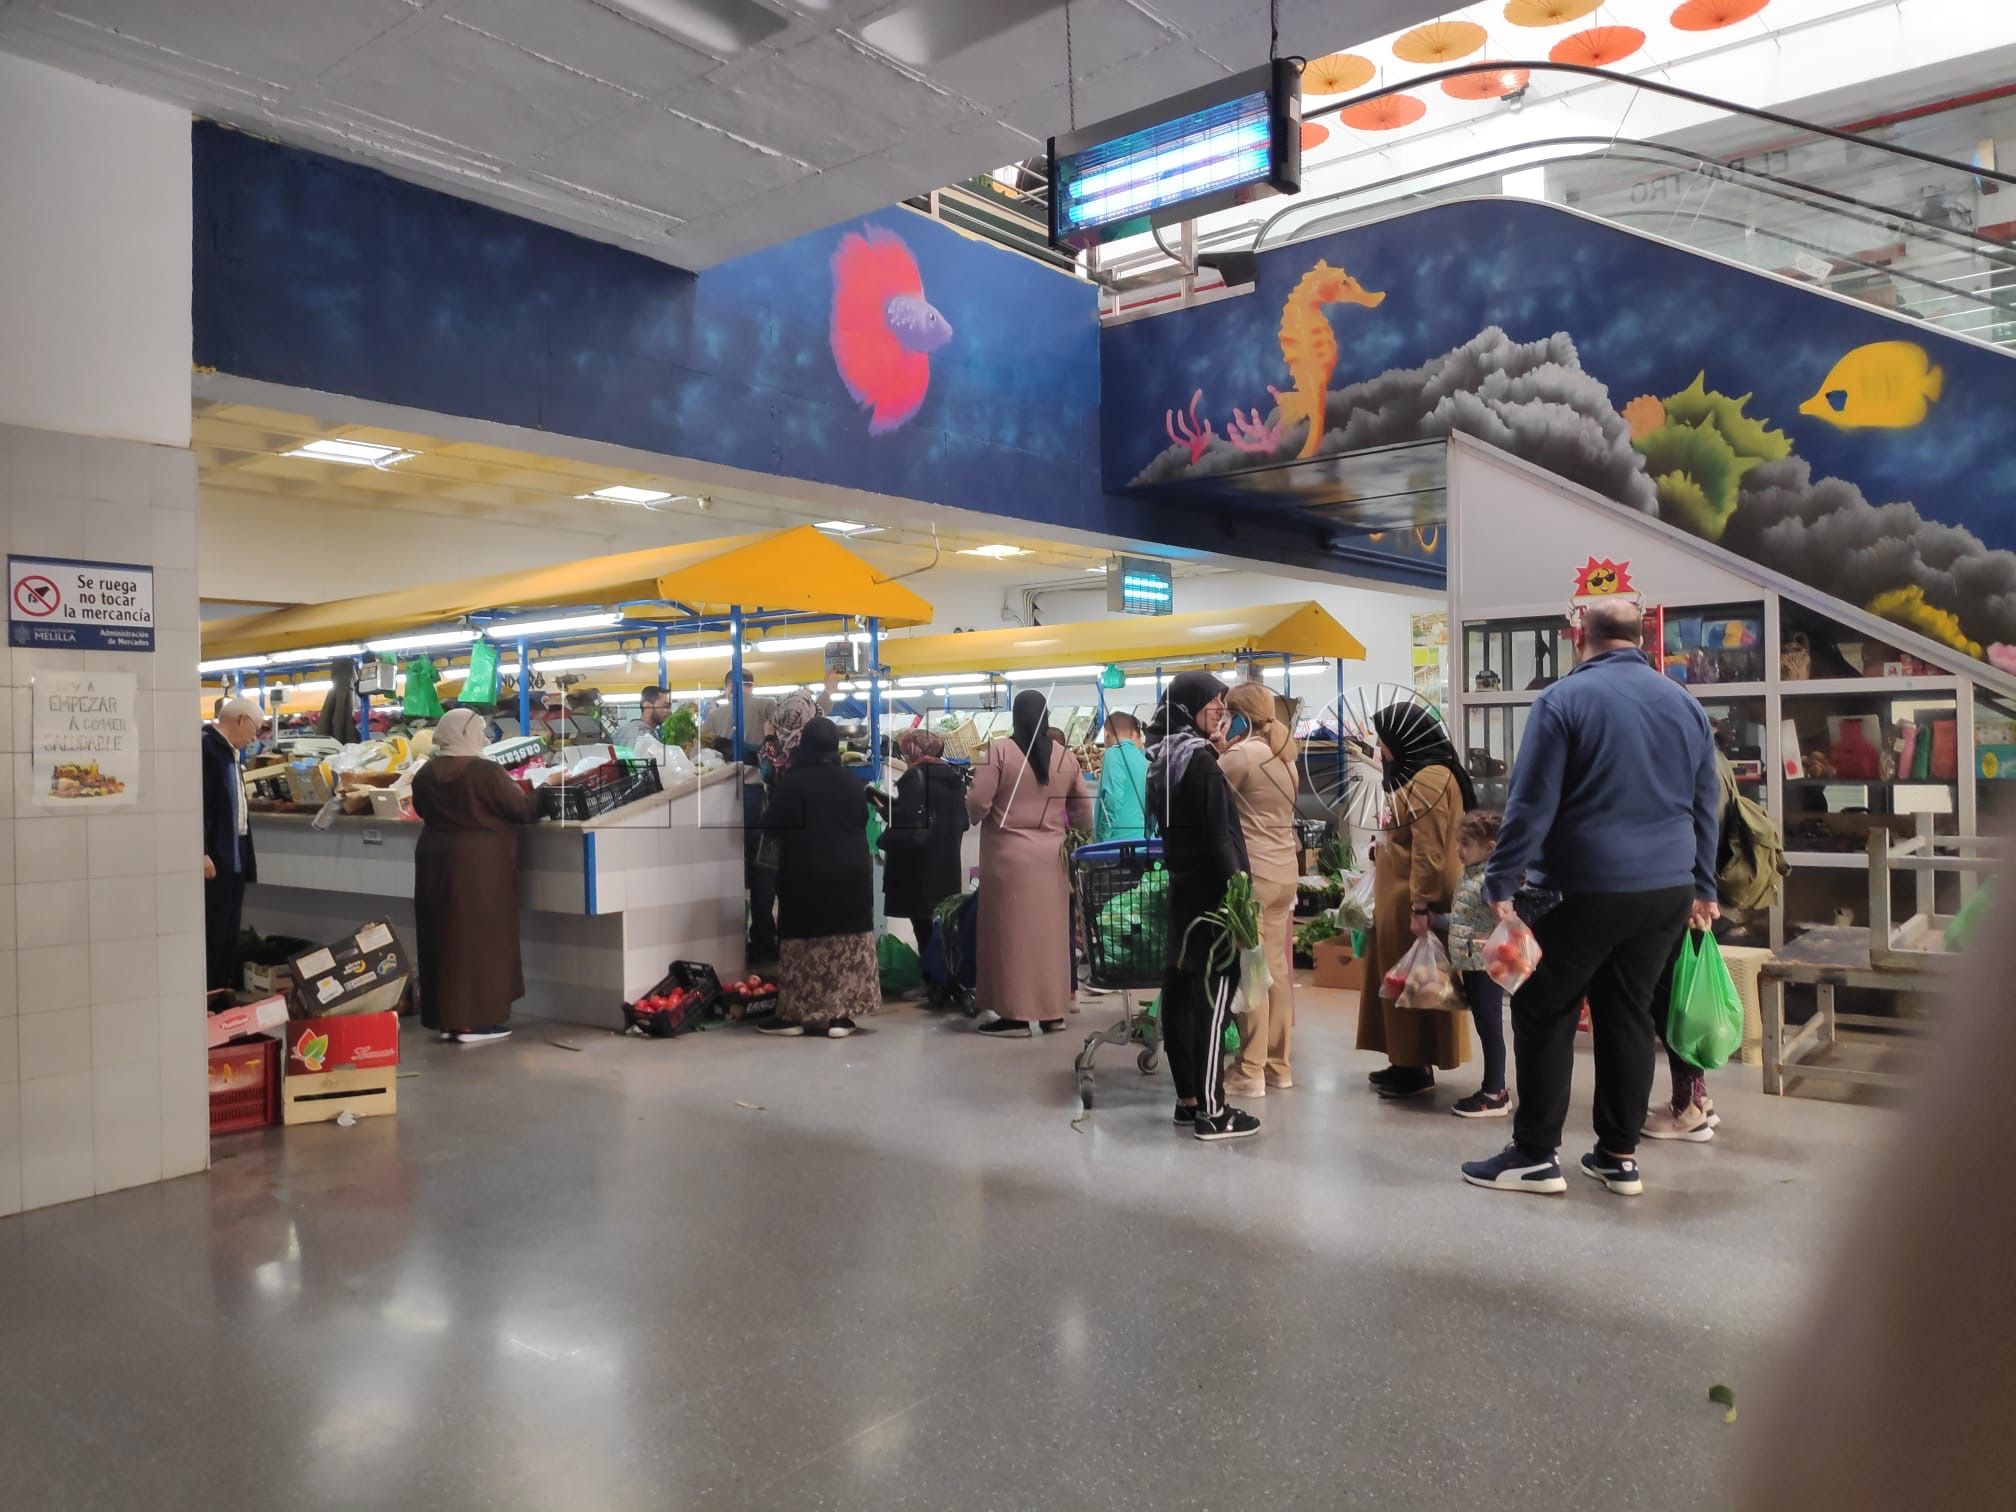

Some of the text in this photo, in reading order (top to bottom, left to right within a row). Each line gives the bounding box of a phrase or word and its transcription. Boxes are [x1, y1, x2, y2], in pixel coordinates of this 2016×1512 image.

[77, 574, 137, 595] Se ruega
[79, 592, 136, 607] no tocar
[63, 603, 151, 622] la mercancía
[34, 631, 77, 642] MELILLA
[100, 629, 149, 638] Administración
[107, 638, 150, 647] de Mercados
[49, 695, 118, 713] EMPEZAR
